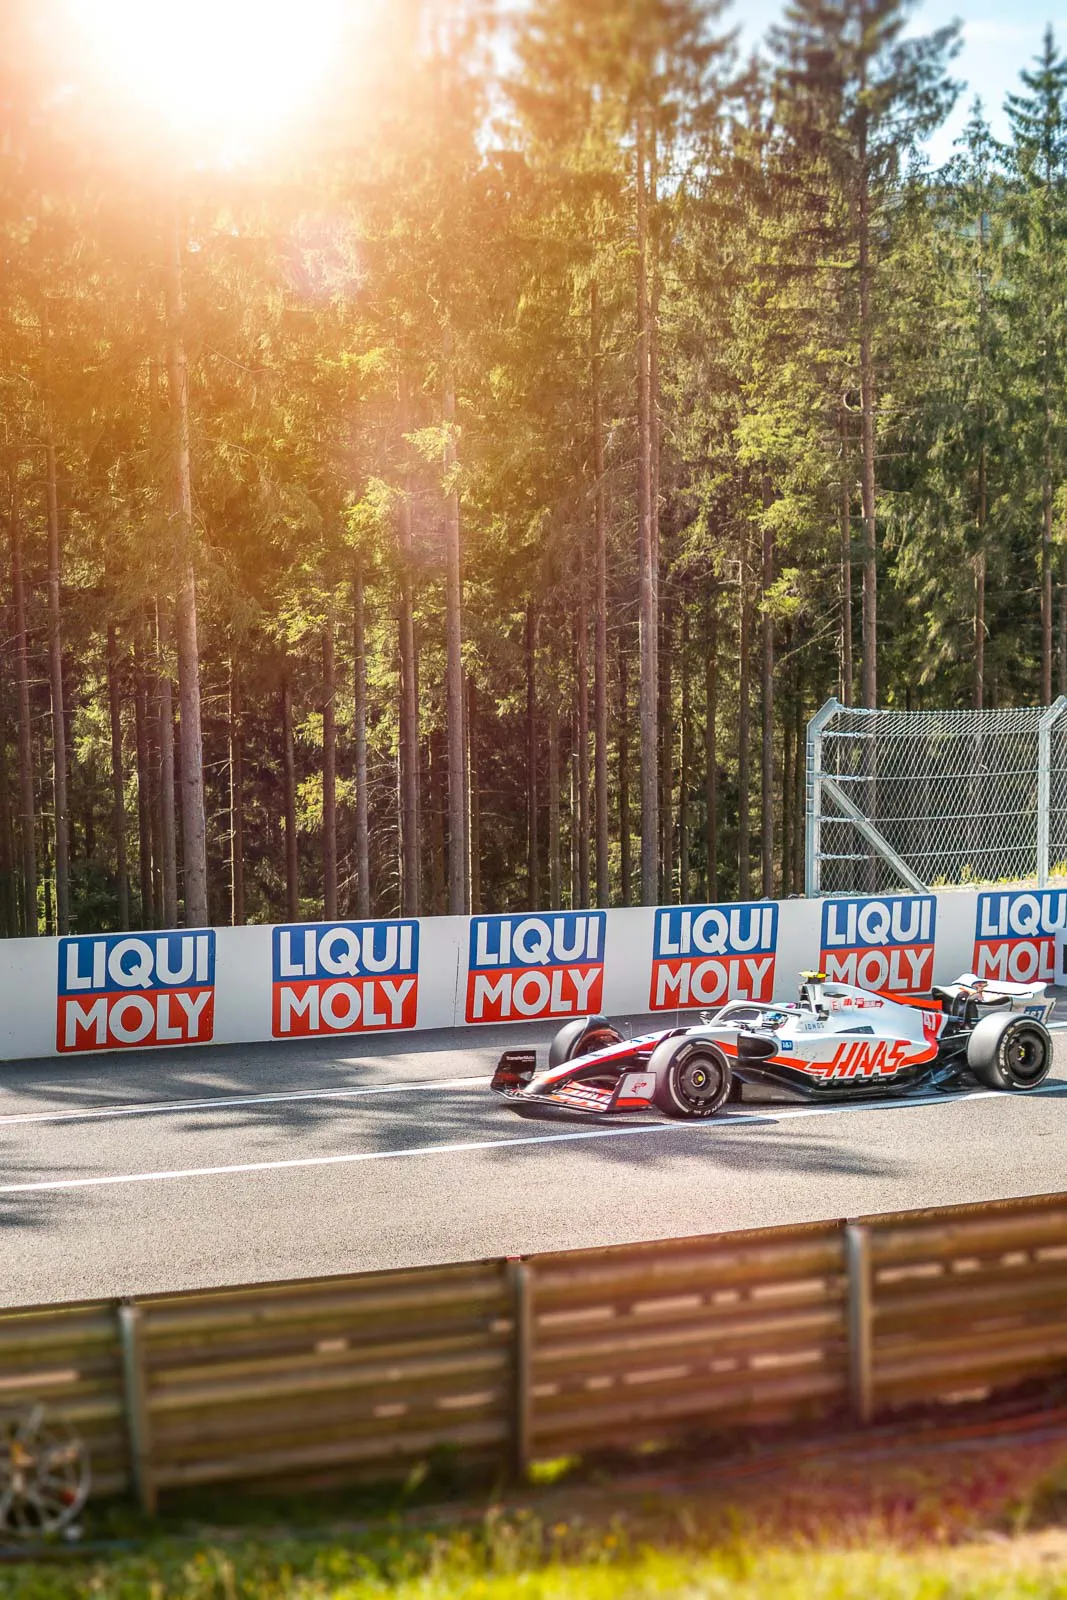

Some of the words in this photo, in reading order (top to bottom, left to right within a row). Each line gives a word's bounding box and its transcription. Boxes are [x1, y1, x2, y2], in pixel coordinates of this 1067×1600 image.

[659, 907, 773, 955] LIQUI
[826, 899, 932, 946] LIQUI
[980, 893, 1067, 936] LIQU
[66, 935, 209, 990] LIQUI
[280, 925, 412, 977] LIQUI
[476, 916, 600, 965] LIQUI
[977, 941, 1055, 982] MOL
[472, 967, 601, 1019] MOLY
[655, 957, 775, 1007] MOLY
[825, 948, 933, 991] MOLY
[64, 991, 212, 1047] MOLY
[279, 979, 416, 1033] MOLY
[805, 1022, 825, 1031] IONOS
[819, 1040, 912, 1080] HAAS
